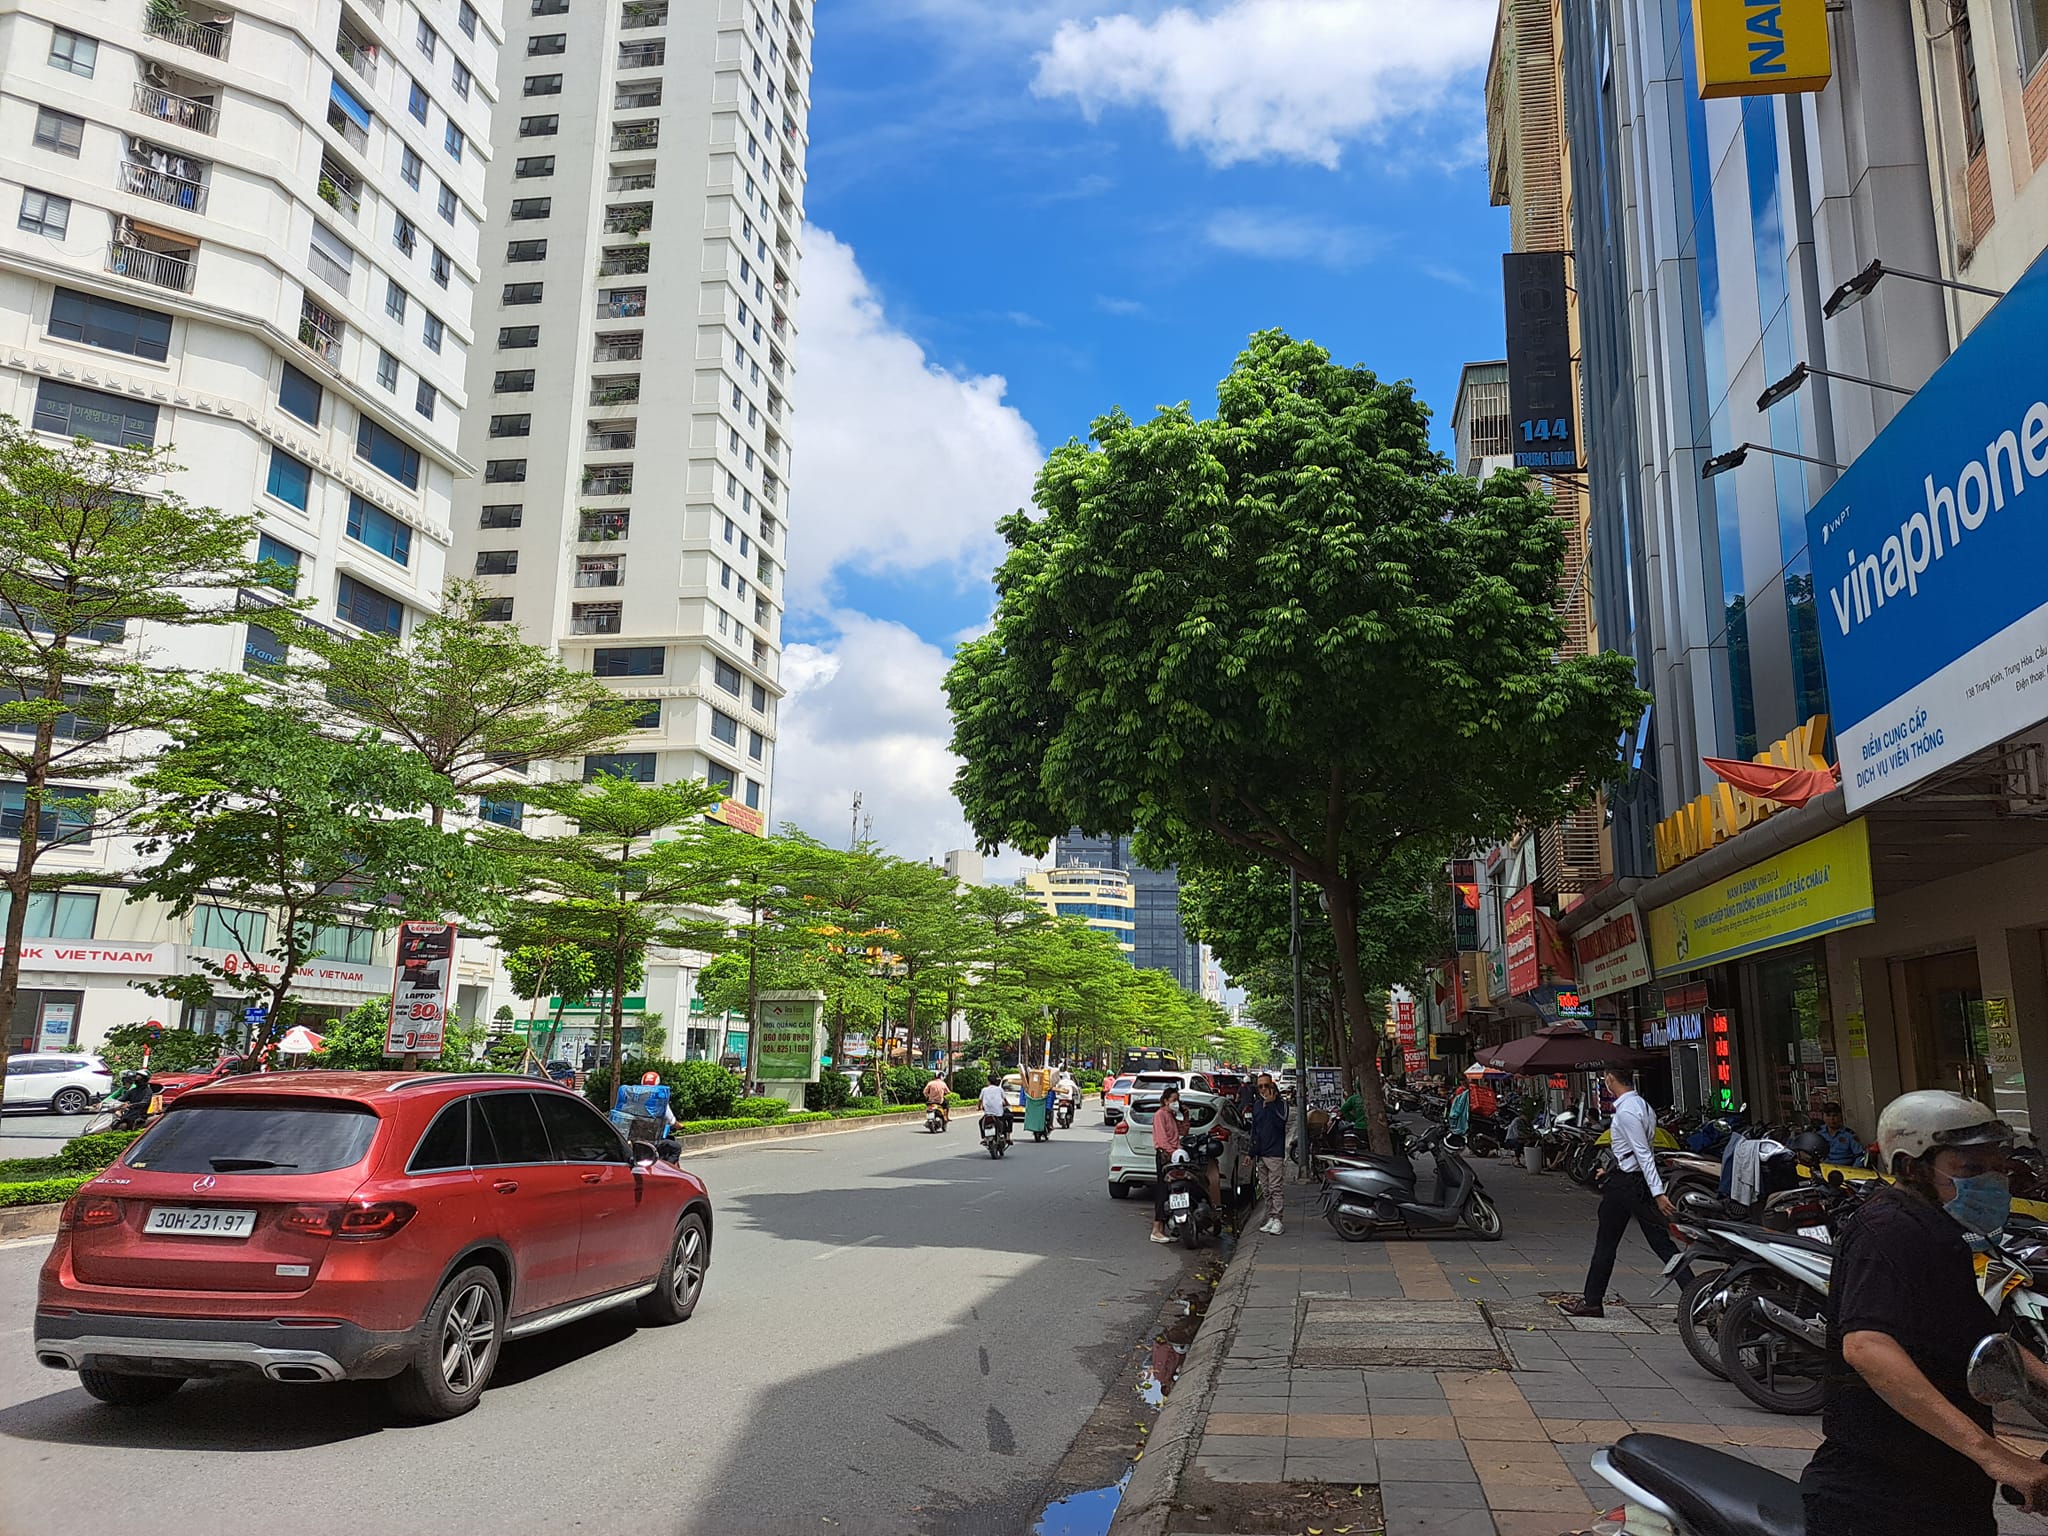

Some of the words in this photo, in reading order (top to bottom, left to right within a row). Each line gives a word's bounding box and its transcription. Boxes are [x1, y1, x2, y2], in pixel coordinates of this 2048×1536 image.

[1744, 0, 1787, 75] NA
[1520, 418, 1568, 442] 144
[1515, 452, 1550, 466] TRUNG
[1551, 447, 1575, 466] KÍNH
[1829, 506, 1851, 533] VNPT
[1830, 401, 2048, 636] vinaphone
[1862, 732, 1882, 760] ĐIỂM
[1883, 723, 1907, 748] CUNG
[1909, 706, 1928, 733] CẤP
[1856, 766, 1876, 789] DỊCH
[1877, 759, 1889, 777] VỤ
[1889, 744, 1910, 769] VIỄN
[1911, 729, 1944, 759] THÔNG
[54, 949, 153, 963] VIETNAM
[242, 962, 281, 974] PUBLIC
[319, 969, 363, 981] VIETNAM
[562, 1035, 587, 1043] BIZPAY
[1666, 1013, 1680, 1041] HAIR
[1680, 1013, 1702, 1040] SALON
